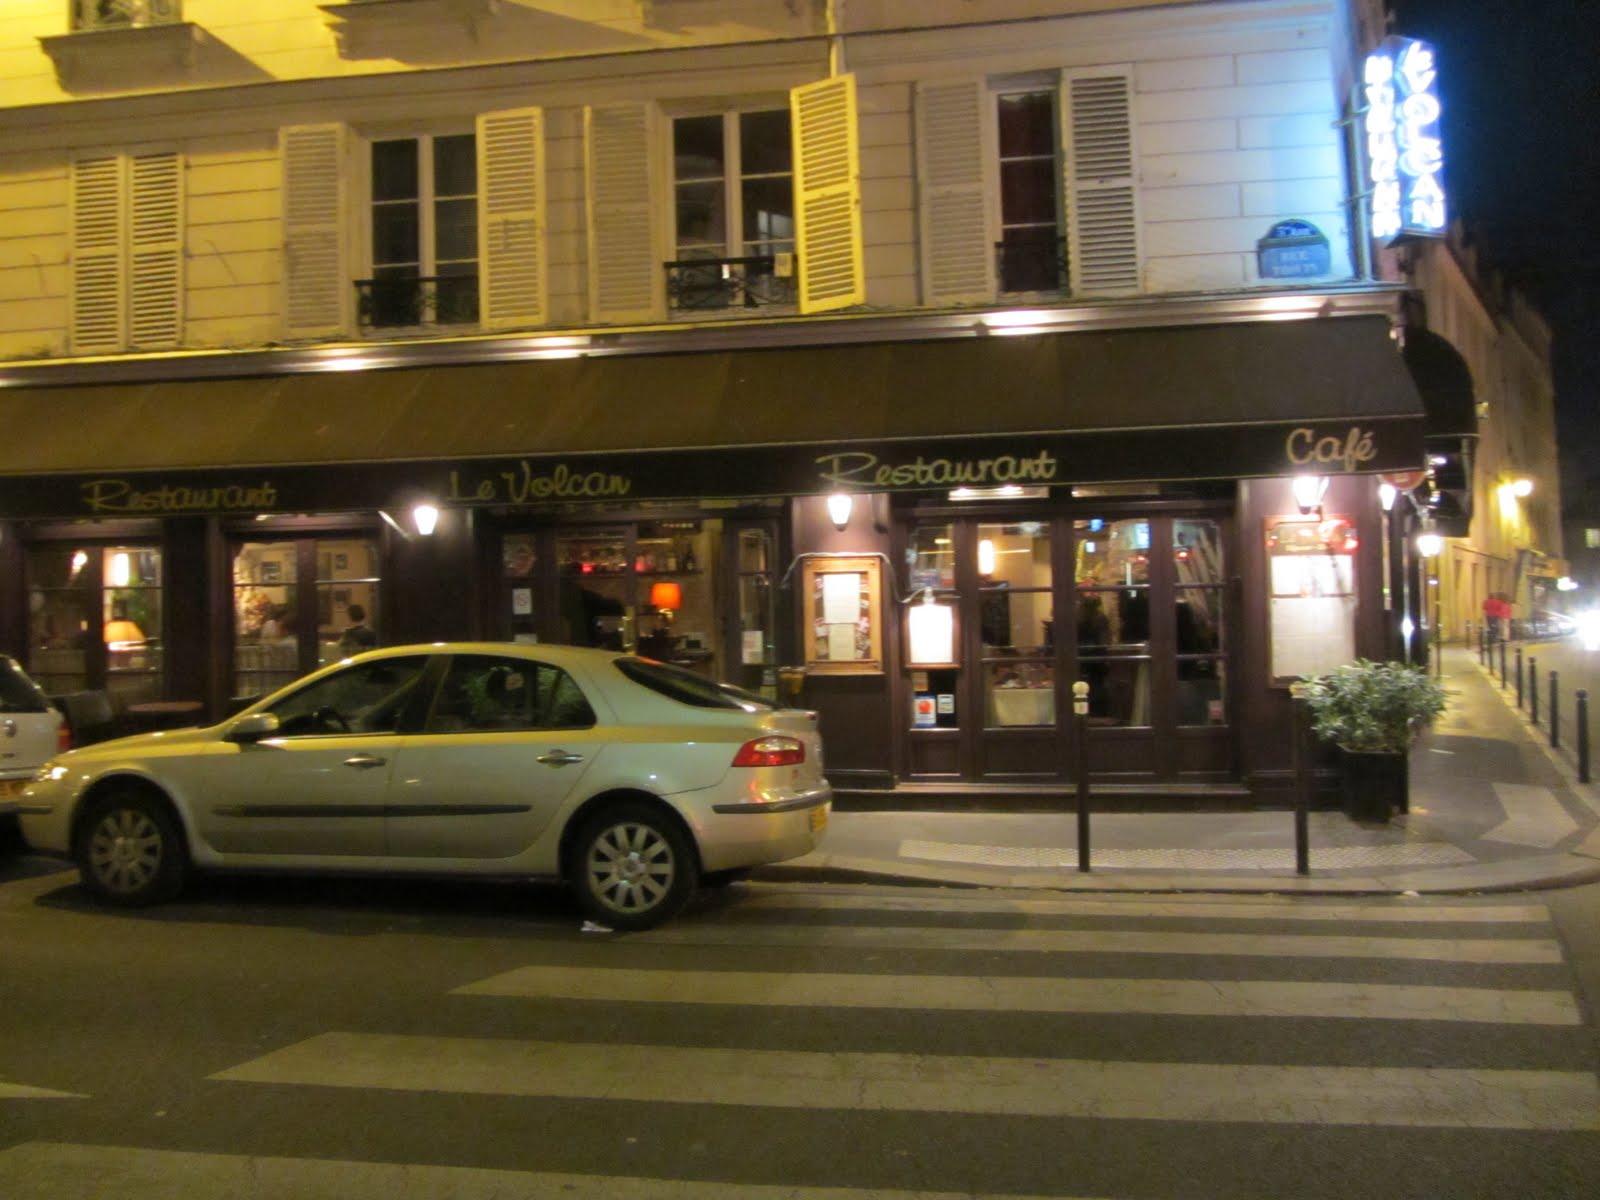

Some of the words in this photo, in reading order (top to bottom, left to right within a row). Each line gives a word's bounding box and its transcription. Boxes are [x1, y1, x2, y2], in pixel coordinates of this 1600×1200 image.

[814, 450, 1057, 487] Restaurant
[1286, 427, 1378, 472] Café
[80, 478, 278, 511] Restaurant
[446, 470, 496, 501] Le
[501, 459, 632, 502] Volcan
